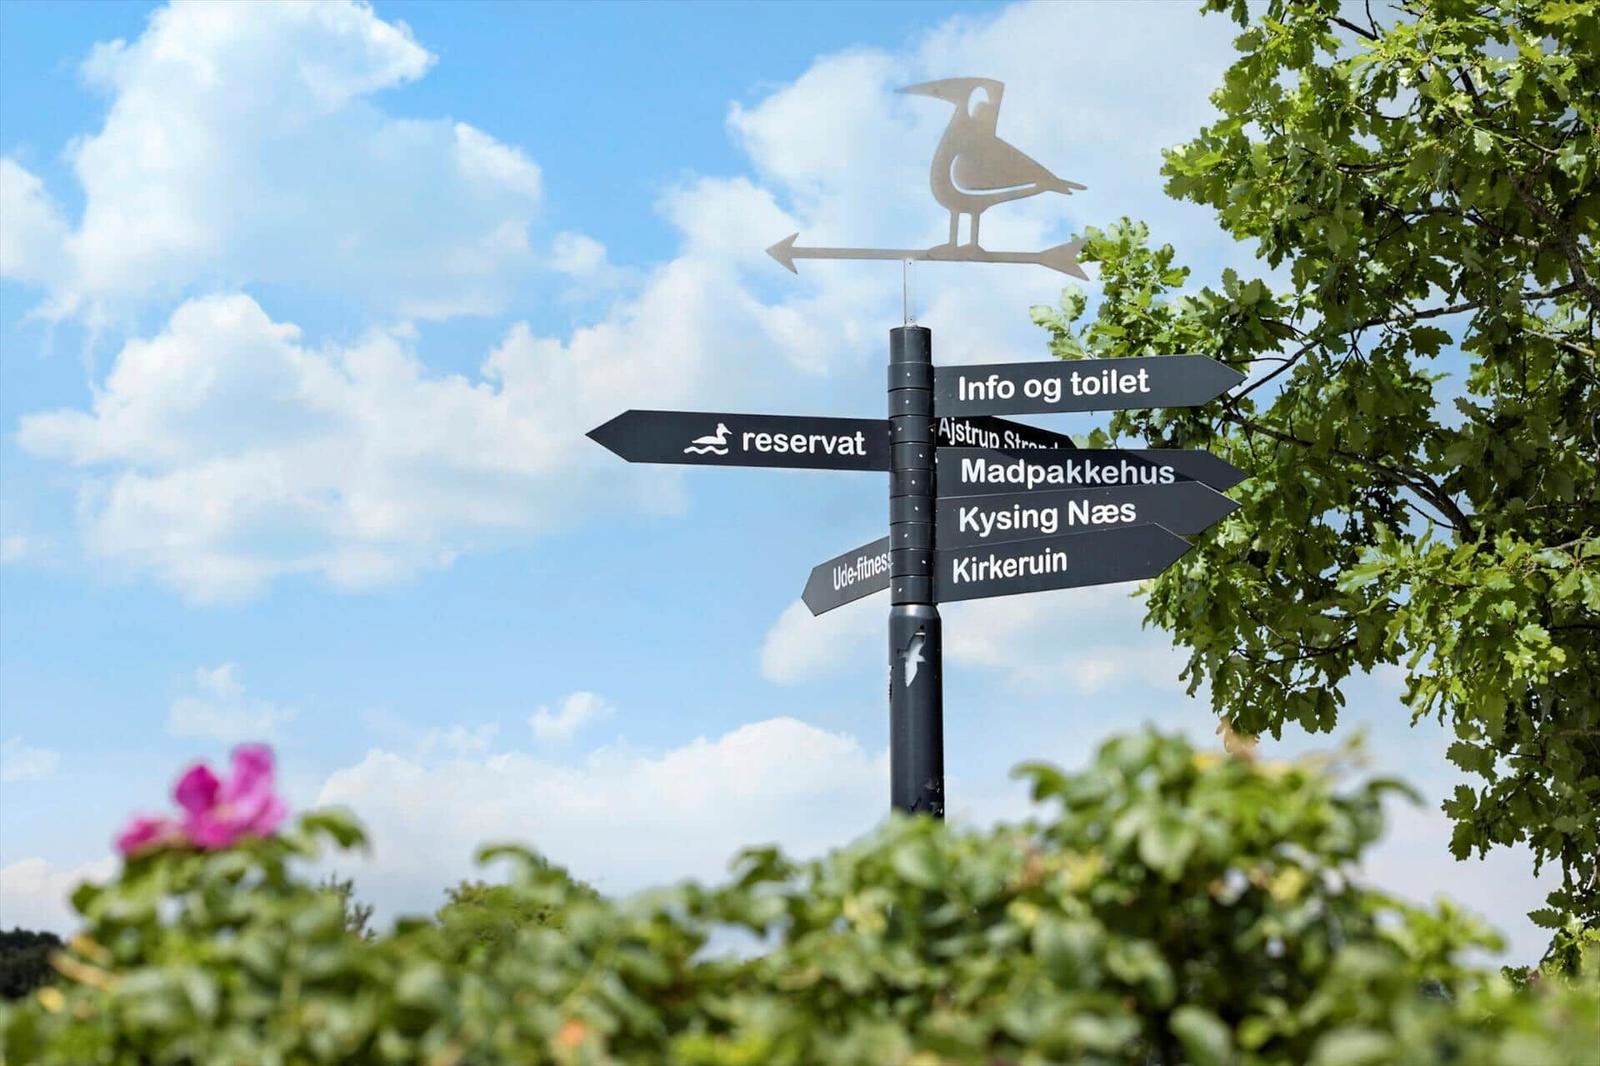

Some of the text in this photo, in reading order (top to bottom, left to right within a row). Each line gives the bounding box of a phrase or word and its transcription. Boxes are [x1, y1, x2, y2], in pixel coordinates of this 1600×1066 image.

[959, 368, 1151, 403] Info og toilet
[742, 431, 867, 456] reservat
[938, 417, 1000, 449] Ajstrup
[961, 457, 1176, 490] Madpakkehus
[959, 499, 1137, 538] Kysing Næs
[952, 547, 1068, 584] Kirkeruin
